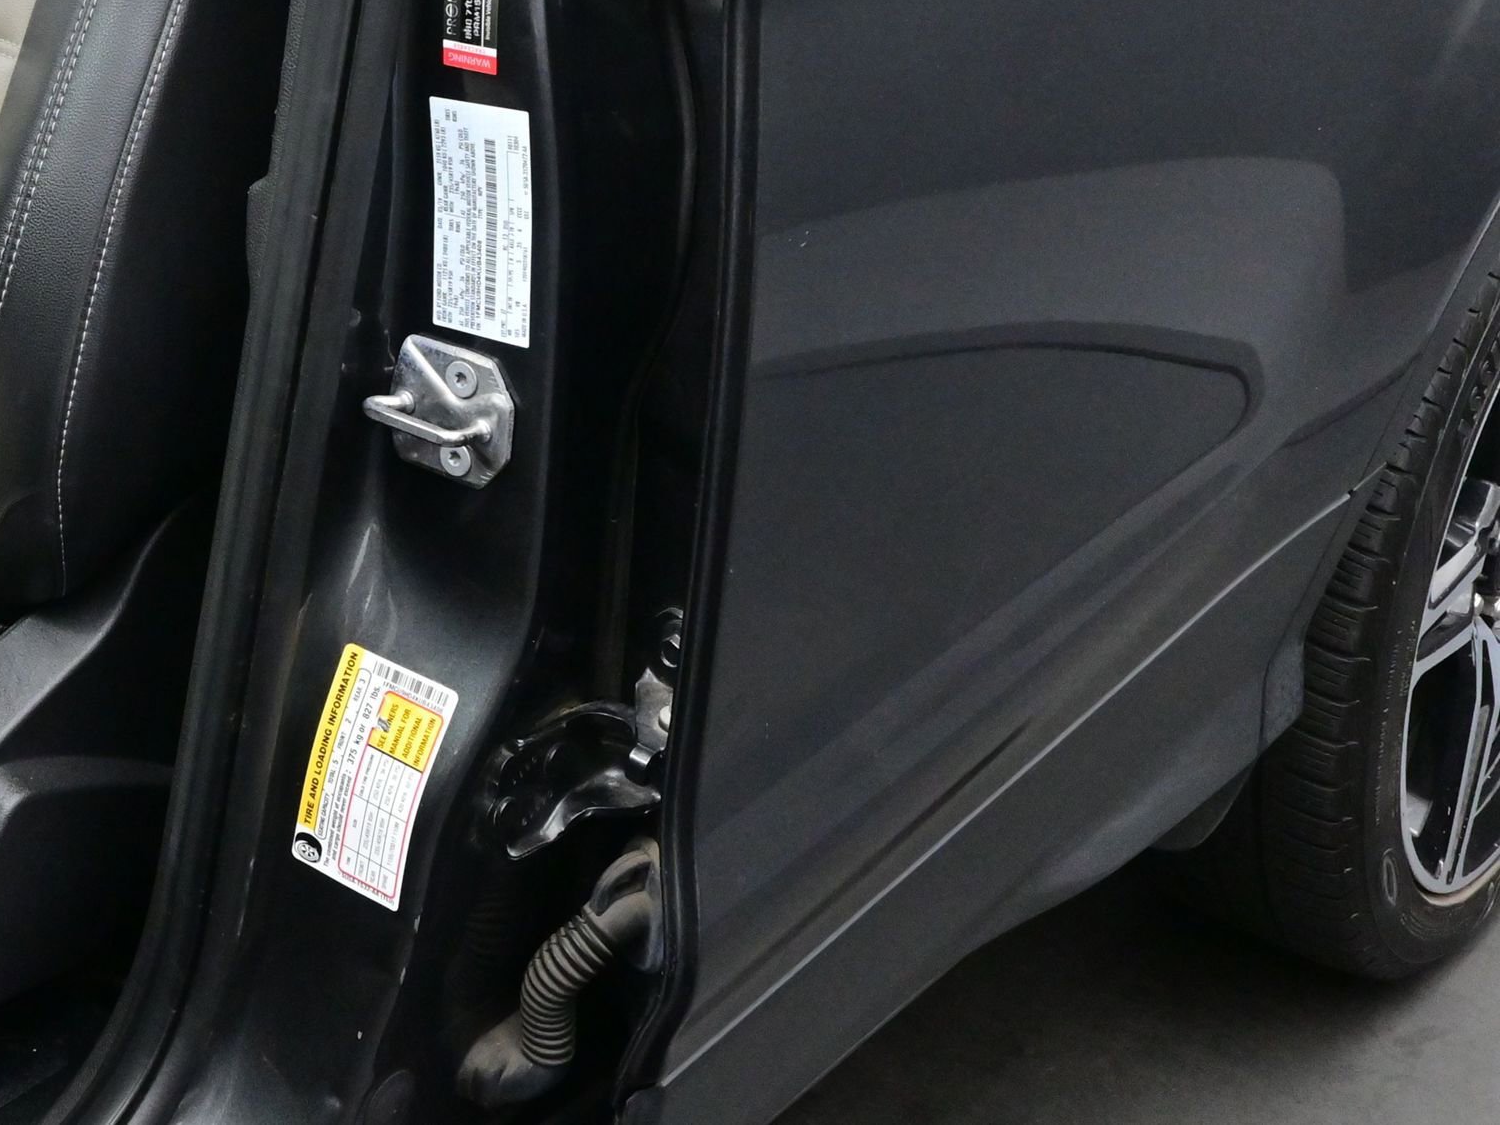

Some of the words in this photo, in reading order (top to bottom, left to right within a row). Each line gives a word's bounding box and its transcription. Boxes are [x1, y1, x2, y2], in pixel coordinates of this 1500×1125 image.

[448, 52, 490, 68] WARNING
[353, 687, 362, 702] REAR
[304, 801, 314, 824] TIRE
[309, 777, 319, 799] AND
[314, 728, 332, 775] LOADING
[327, 651, 358, 726] INFORMATION
[337, 731, 346, 750] FRONT
[347, 748, 357, 765] 375
[354, 734, 364, 746] kg
[359, 723, 365, 733] or
[363, 703, 373, 720] 827
[377, 733, 388, 749] SEE
[390, 724, 405, 755] MANUAL
[401, 708, 411, 723] FOR
[402, 716, 423, 759] ADDITIONAL
[414, 718, 436, 767] INFORMATION
[322, 793, 330, 817] CAPACITY
[326, 829, 334, 856] combined
[331, 810, 339, 829] weight
[336, 773, 348, 803] occupants
[336, 814, 344, 833] should
[344, 776, 353, 797] exceed
